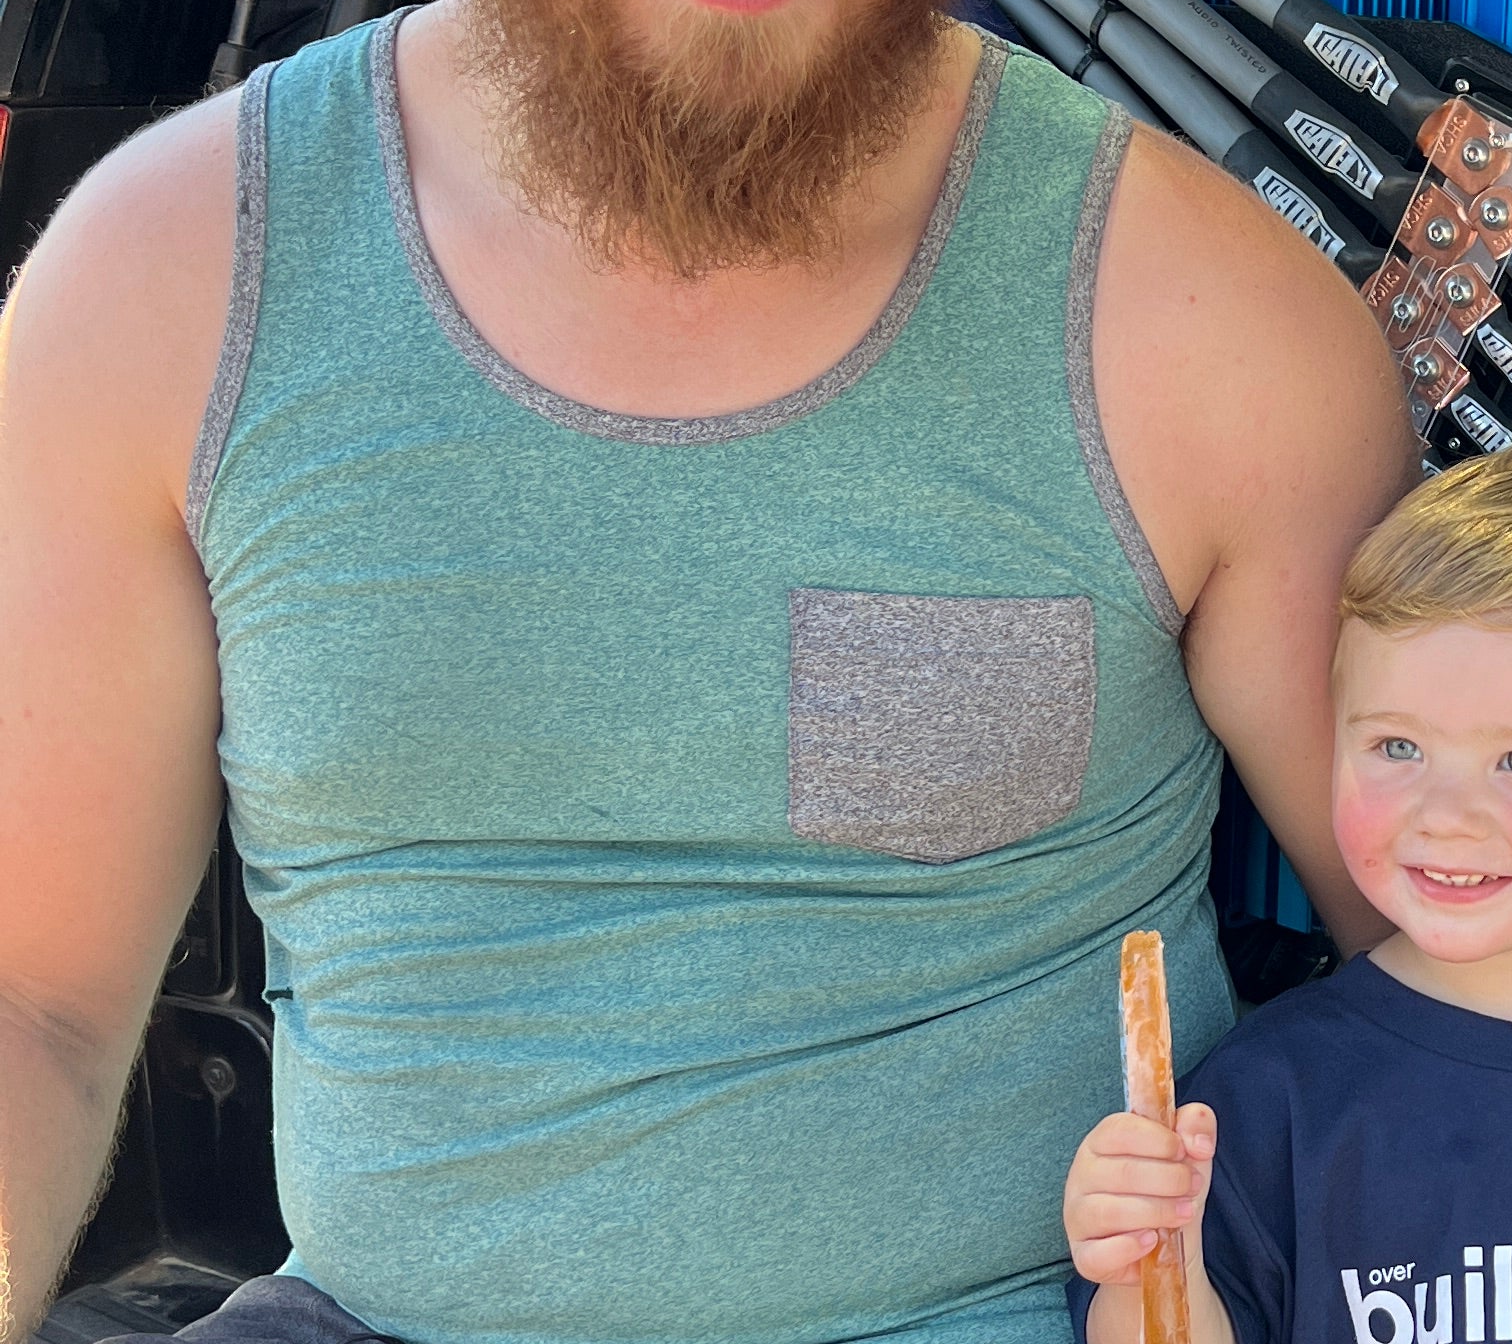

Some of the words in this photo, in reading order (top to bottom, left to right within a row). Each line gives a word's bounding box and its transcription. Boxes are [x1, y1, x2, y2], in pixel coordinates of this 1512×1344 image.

[1224, 34, 1267, 74] TWISTED
[1313, 31, 1389, 97] GATELY
[1294, 118, 1372, 189] GATELY
[1369, 1262, 1415, 1285] over
